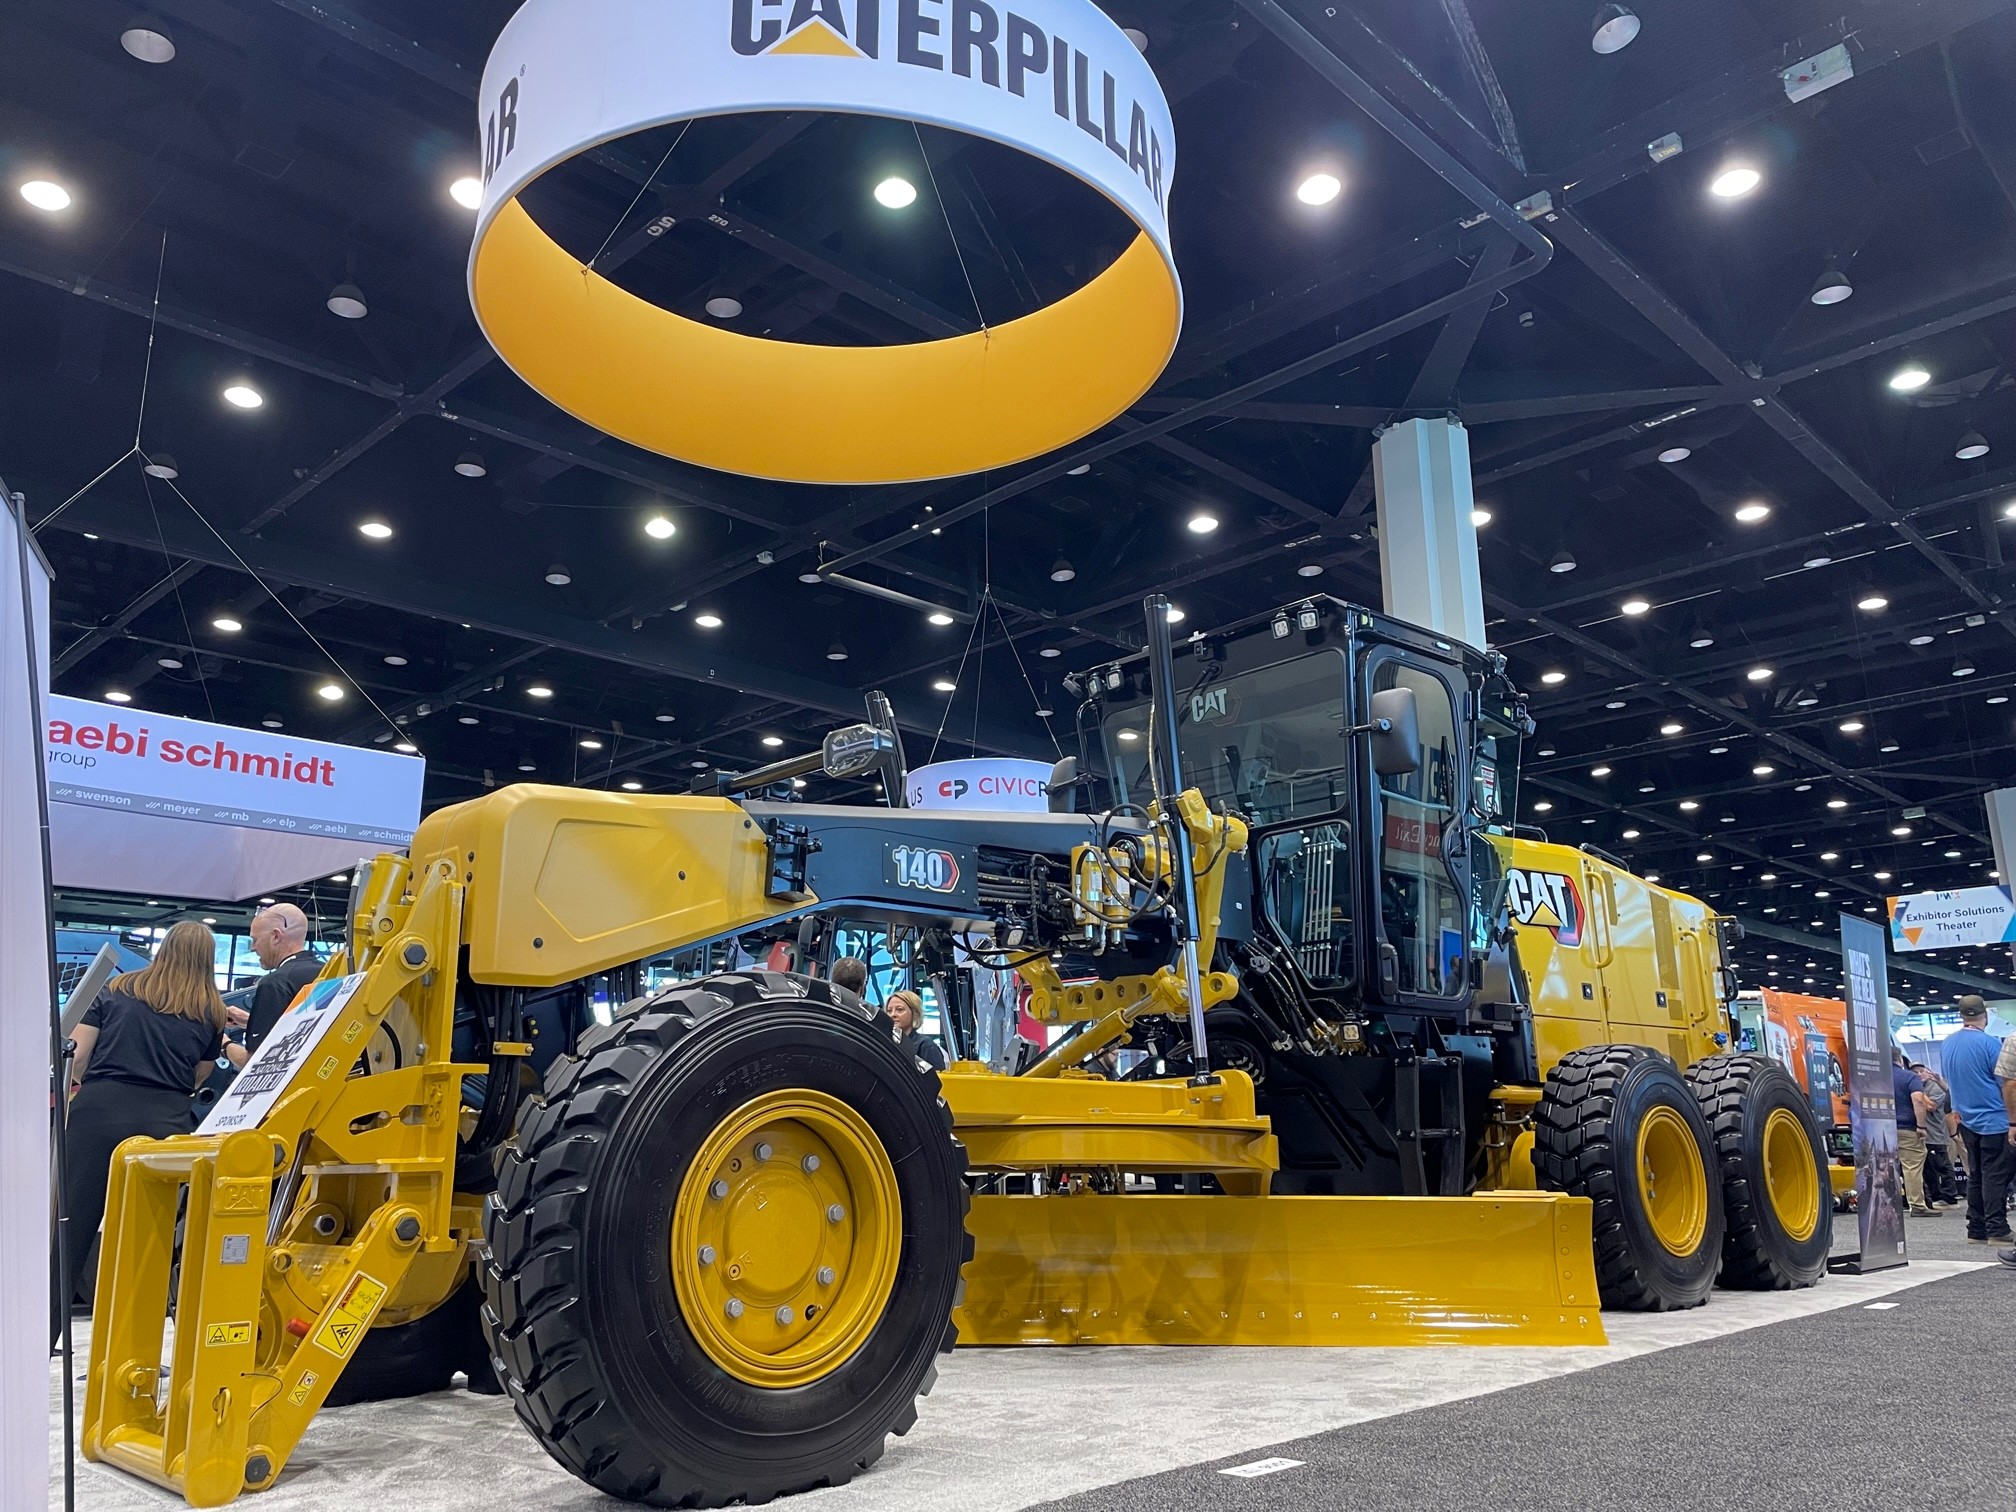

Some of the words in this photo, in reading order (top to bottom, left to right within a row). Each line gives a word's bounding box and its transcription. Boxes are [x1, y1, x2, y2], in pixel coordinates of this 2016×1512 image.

[1191, 688, 1227, 723] CAT
[49, 720, 149, 758] aebi
[160, 739, 336, 787] schmidt
[75, 790, 131, 806] swenson
[163, 802, 201, 815] meyer
[231, 811, 250, 821] mb
[279, 817, 296, 829] elp
[324, 824, 347, 835] aebi
[895, 848, 943, 888] 140
[1506, 868, 1569, 928] CAT
[1906, 910, 1952, 922] Exhibitor
[1954, 905, 2005, 917] Solutions
[1936, 921, 1977, 931] Theater
[1955, 933, 1962, 942] 1
[215, 1114, 247, 1127] SPONSOR
[223, 1185, 265, 1210] CAT
